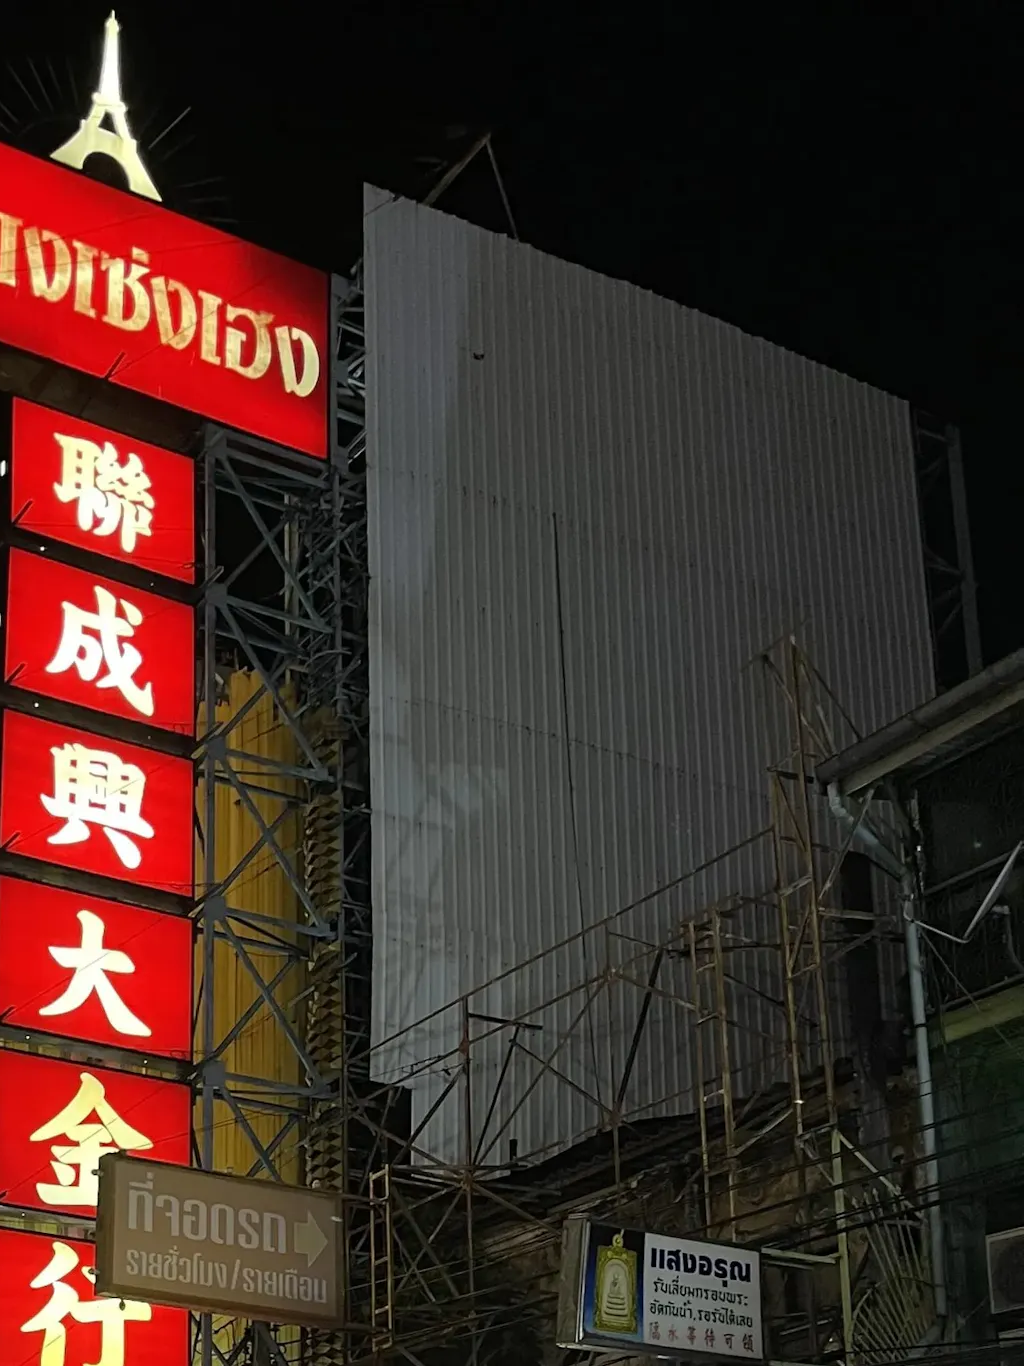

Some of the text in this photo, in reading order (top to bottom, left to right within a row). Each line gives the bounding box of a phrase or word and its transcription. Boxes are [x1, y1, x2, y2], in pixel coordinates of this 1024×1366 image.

[127, 1171, 288, 1254] ที่จอดรถ
[650, 1247, 751, 1288] แสงอรุณ
